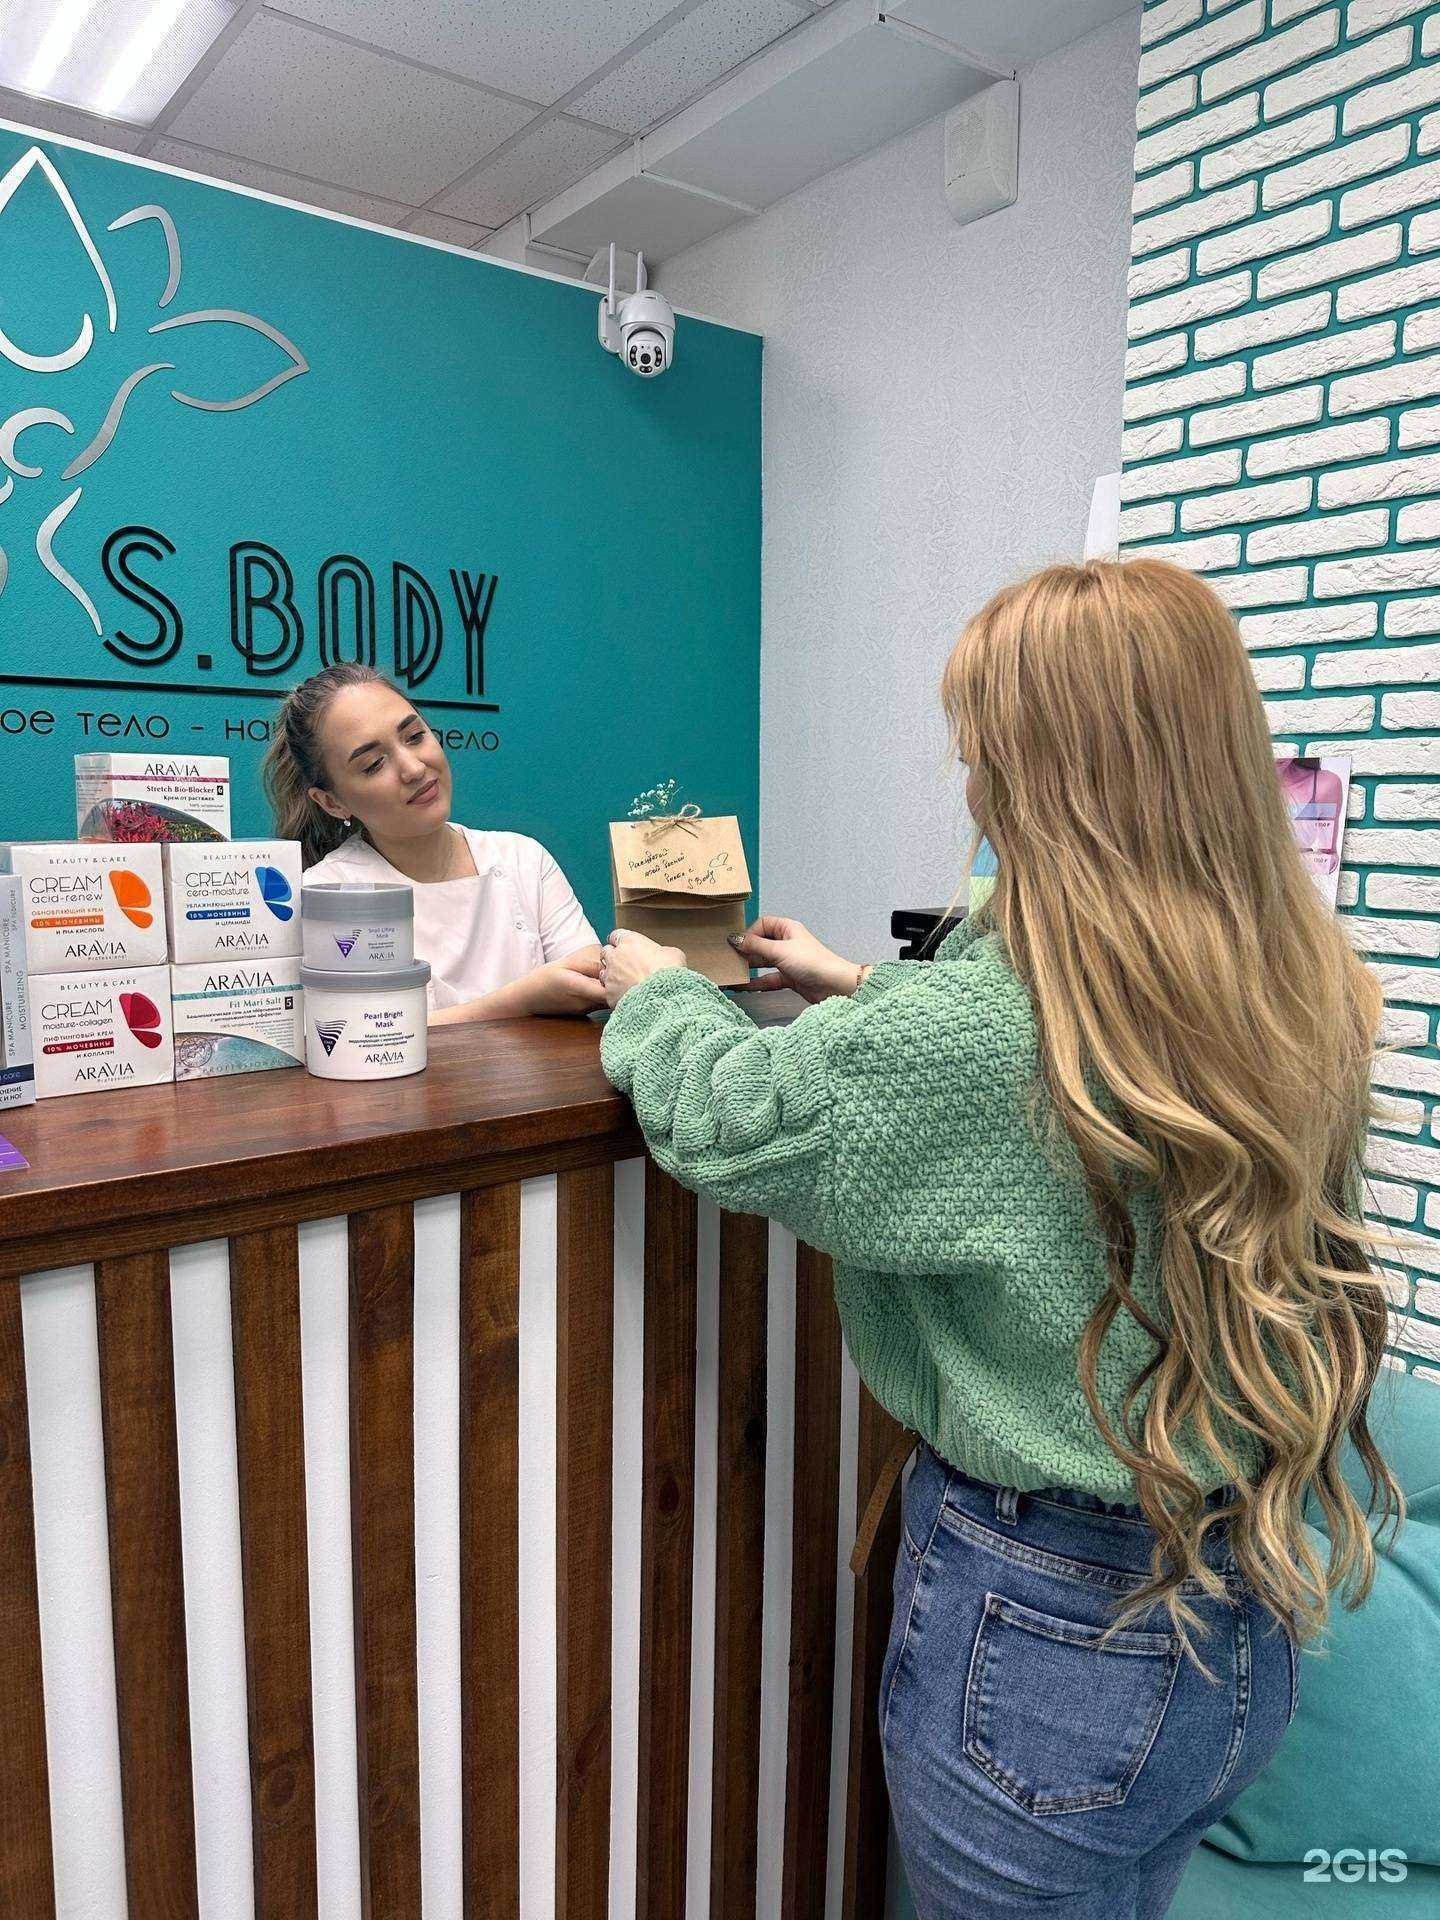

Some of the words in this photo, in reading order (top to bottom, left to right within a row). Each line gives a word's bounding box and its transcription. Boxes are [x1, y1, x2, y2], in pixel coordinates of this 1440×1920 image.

[102, 525, 498, 695] S.BODY
[76, 712, 169, 738] тело
[144, 761, 200, 776] ARAVIA
[146, 785, 173, 794] Stretch
[29, 875, 103, 893] CREAM
[185, 870, 250, 887] CREAM
[32, 893, 103, 904] acid-renew
[186, 888, 250, 897] cera-moisture
[3, 918, 11, 958] MANICURE
[215, 931, 269, 948] ARAVIA
[64, 940, 127, 957] ARAVIA
[60, 982, 99, 991] BEAUTY
[112, 979, 137, 987] CARE
[203, 969, 275, 991] ARAVIA
[17, 970, 27, 1030] MOISTURIZING
[243, 998, 263, 1007] Mari
[266, 996, 281, 1005] Salt
[41, 998, 113, 1020] CREAM
[363, 1012, 383, 1020] Pearl
[384, 1011, 403, 1019] Bright
[5, 1001, 14, 1041] MANICURE
[375, 1020, 394, 1028] Mask
[364, 1051, 404, 1063] ARAVIA
[75, 1062, 134, 1081] ARAVIA
